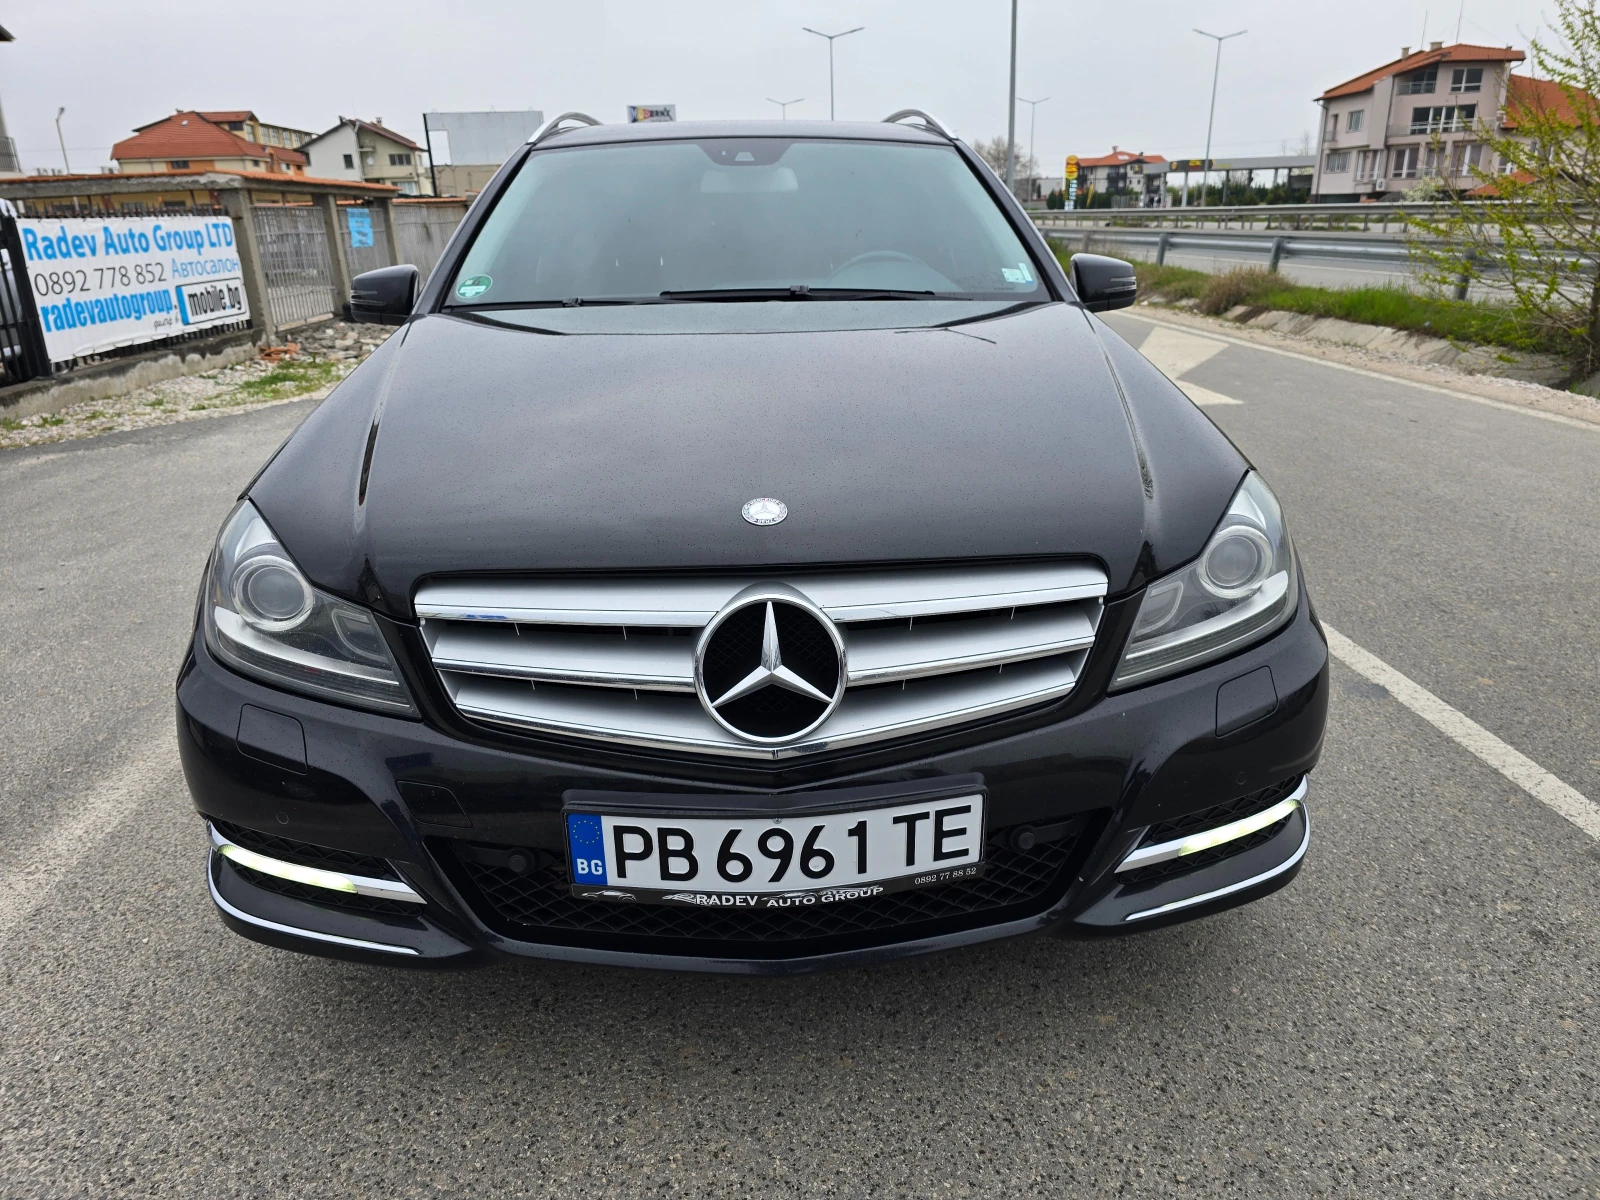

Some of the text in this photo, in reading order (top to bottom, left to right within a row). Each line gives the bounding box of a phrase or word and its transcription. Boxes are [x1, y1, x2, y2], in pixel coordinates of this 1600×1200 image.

[22, 222, 233, 261] Radev Auto Group LTD
[171, 257, 240, 279] Автосалон
[34, 262, 167, 297] 0892 778 852
[612, 804, 972, 883] PB 6961 TE
[576, 858, 604, 876] BG
[914, 867, 978, 886] 0892 77 88 52
[695, 886, 885, 908] RADEV AUTO GROUP
